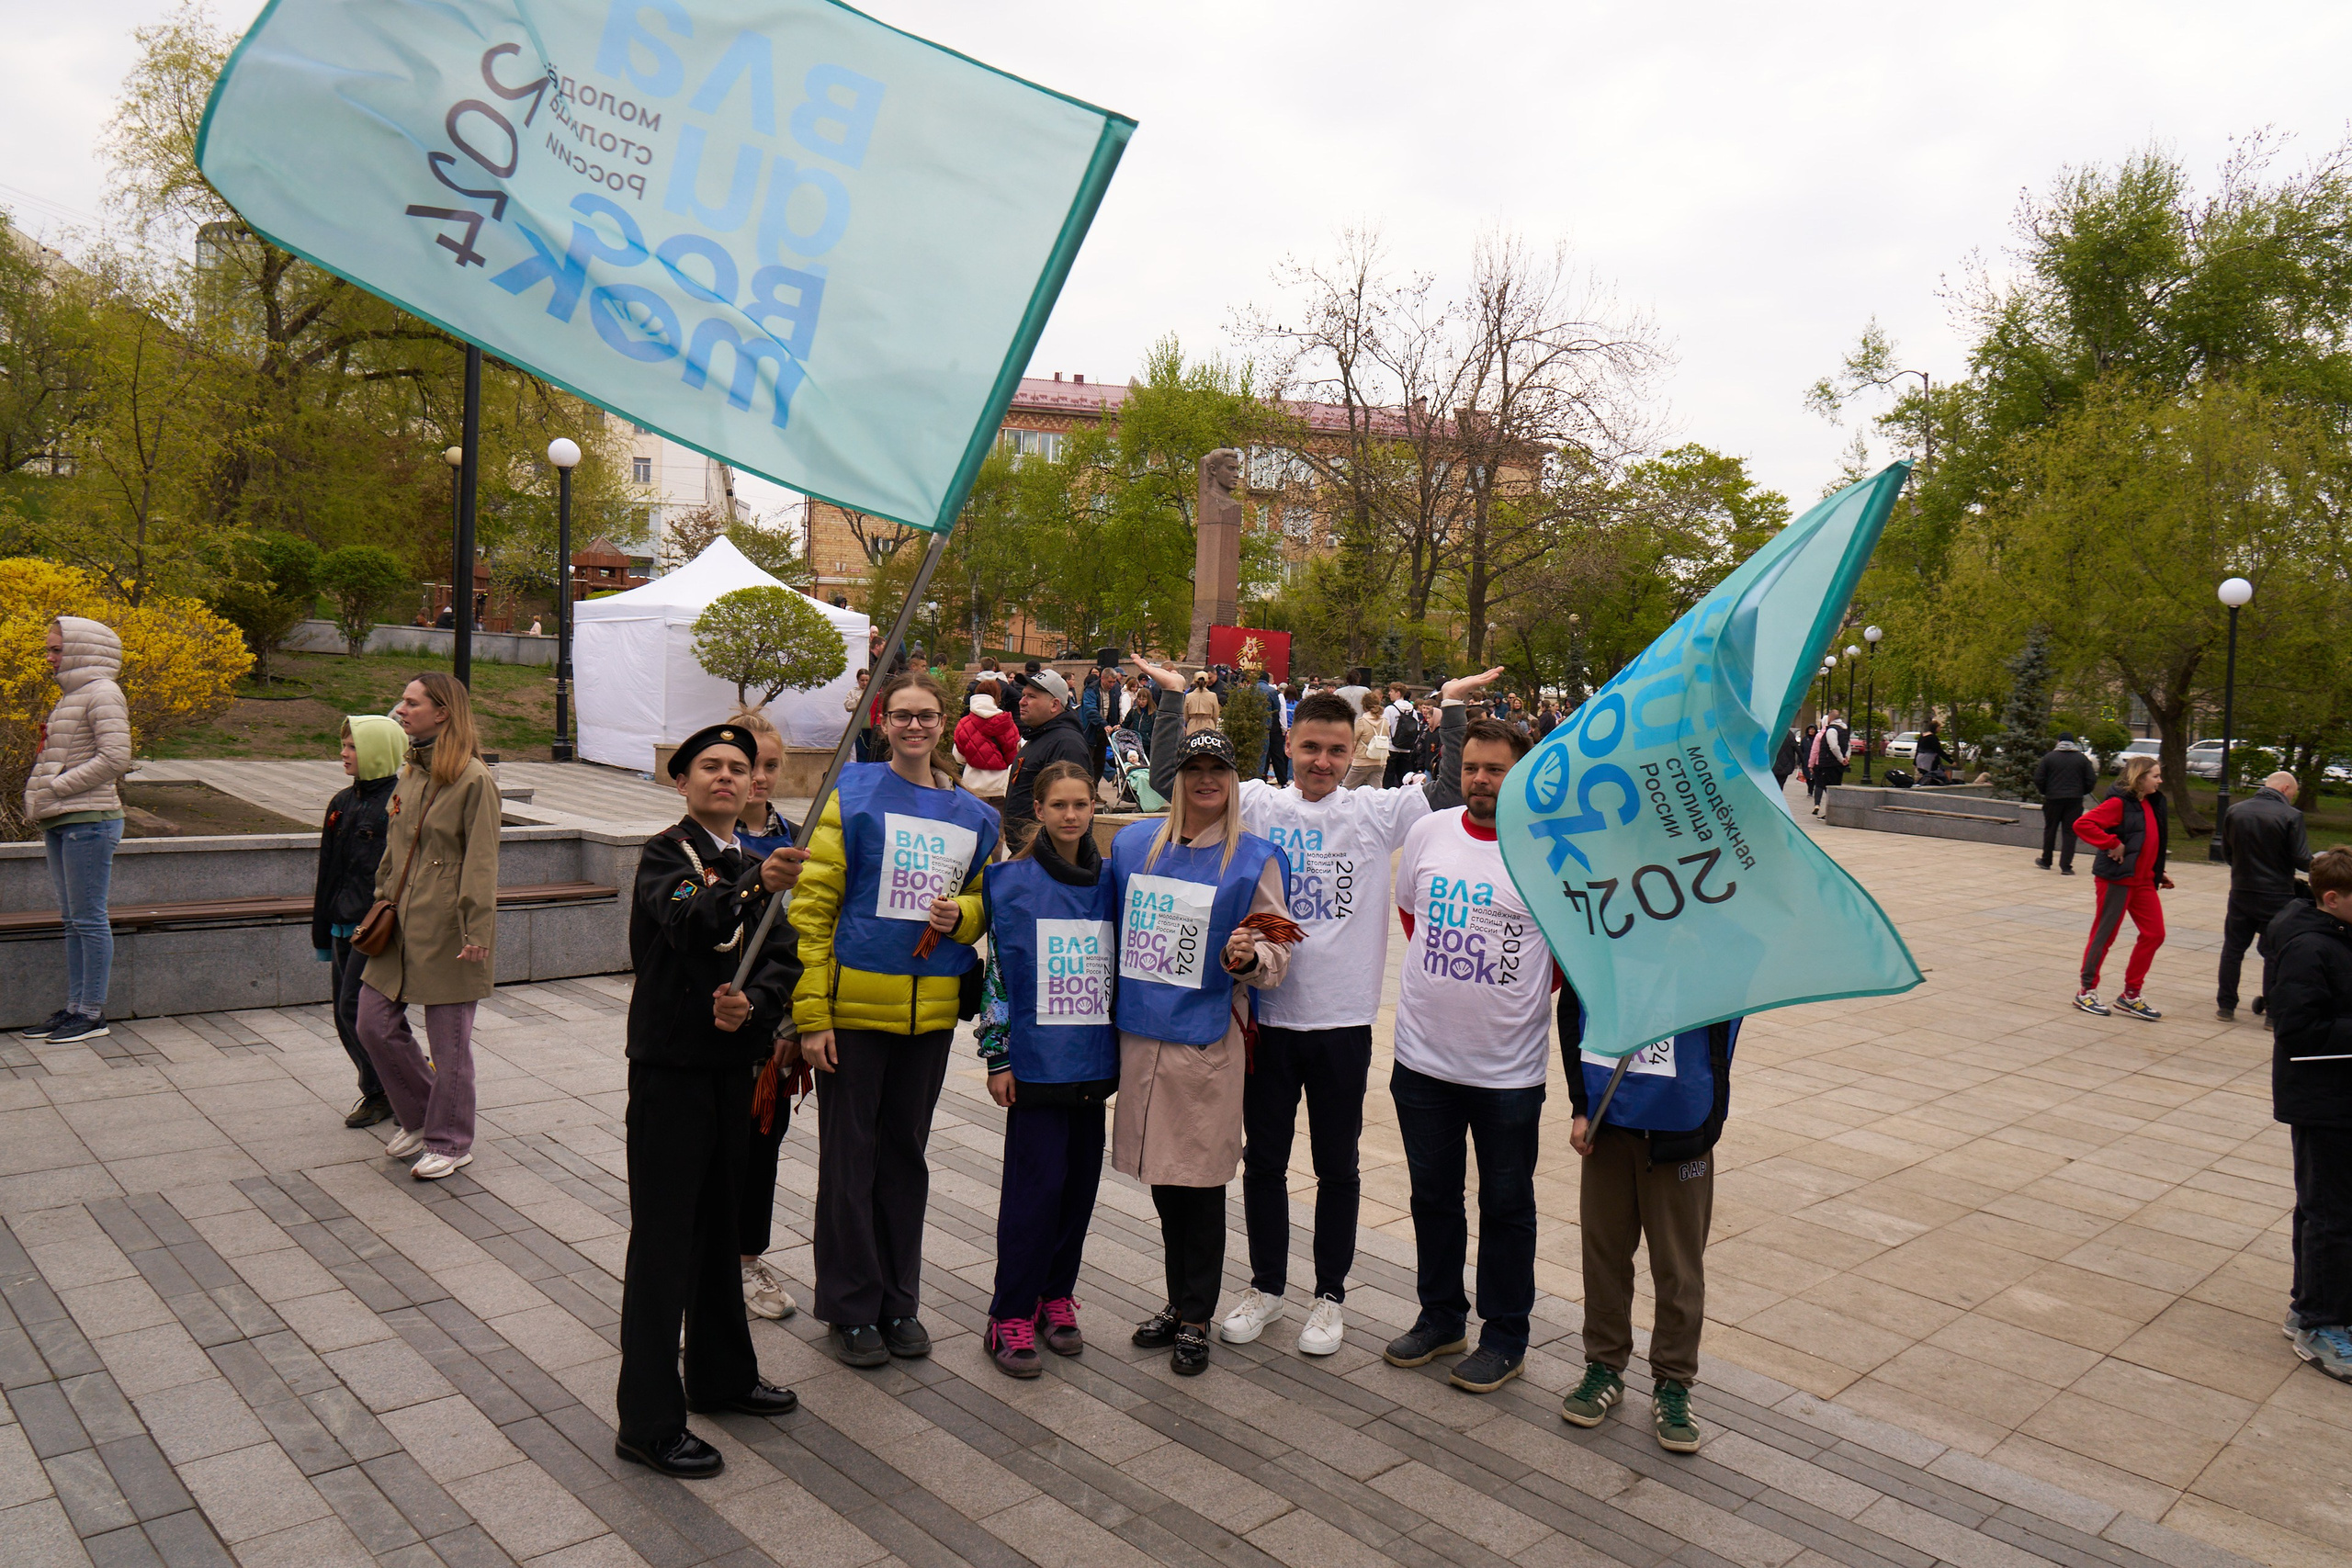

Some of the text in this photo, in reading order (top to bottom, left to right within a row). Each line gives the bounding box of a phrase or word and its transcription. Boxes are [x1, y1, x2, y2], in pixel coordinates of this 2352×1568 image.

[1191, 736, 1222, 748] GUCCI
[1639, 761, 1683, 840] России
[1666, 757, 1713, 843] столица
[1686, 746, 1757, 872] молодёжная
[1335, 860, 1354, 919] 2024
[1472, 907, 1521, 920] молодёжная
[1562, 847, 1737, 940] 2024
[1469, 923, 1498, 934] России
[1471, 915, 1503, 927] столица
[1175, 924, 1198, 976] 2024
[1498, 921, 1523, 986] 2024
[1679, 1160, 1707, 1182] GAP
